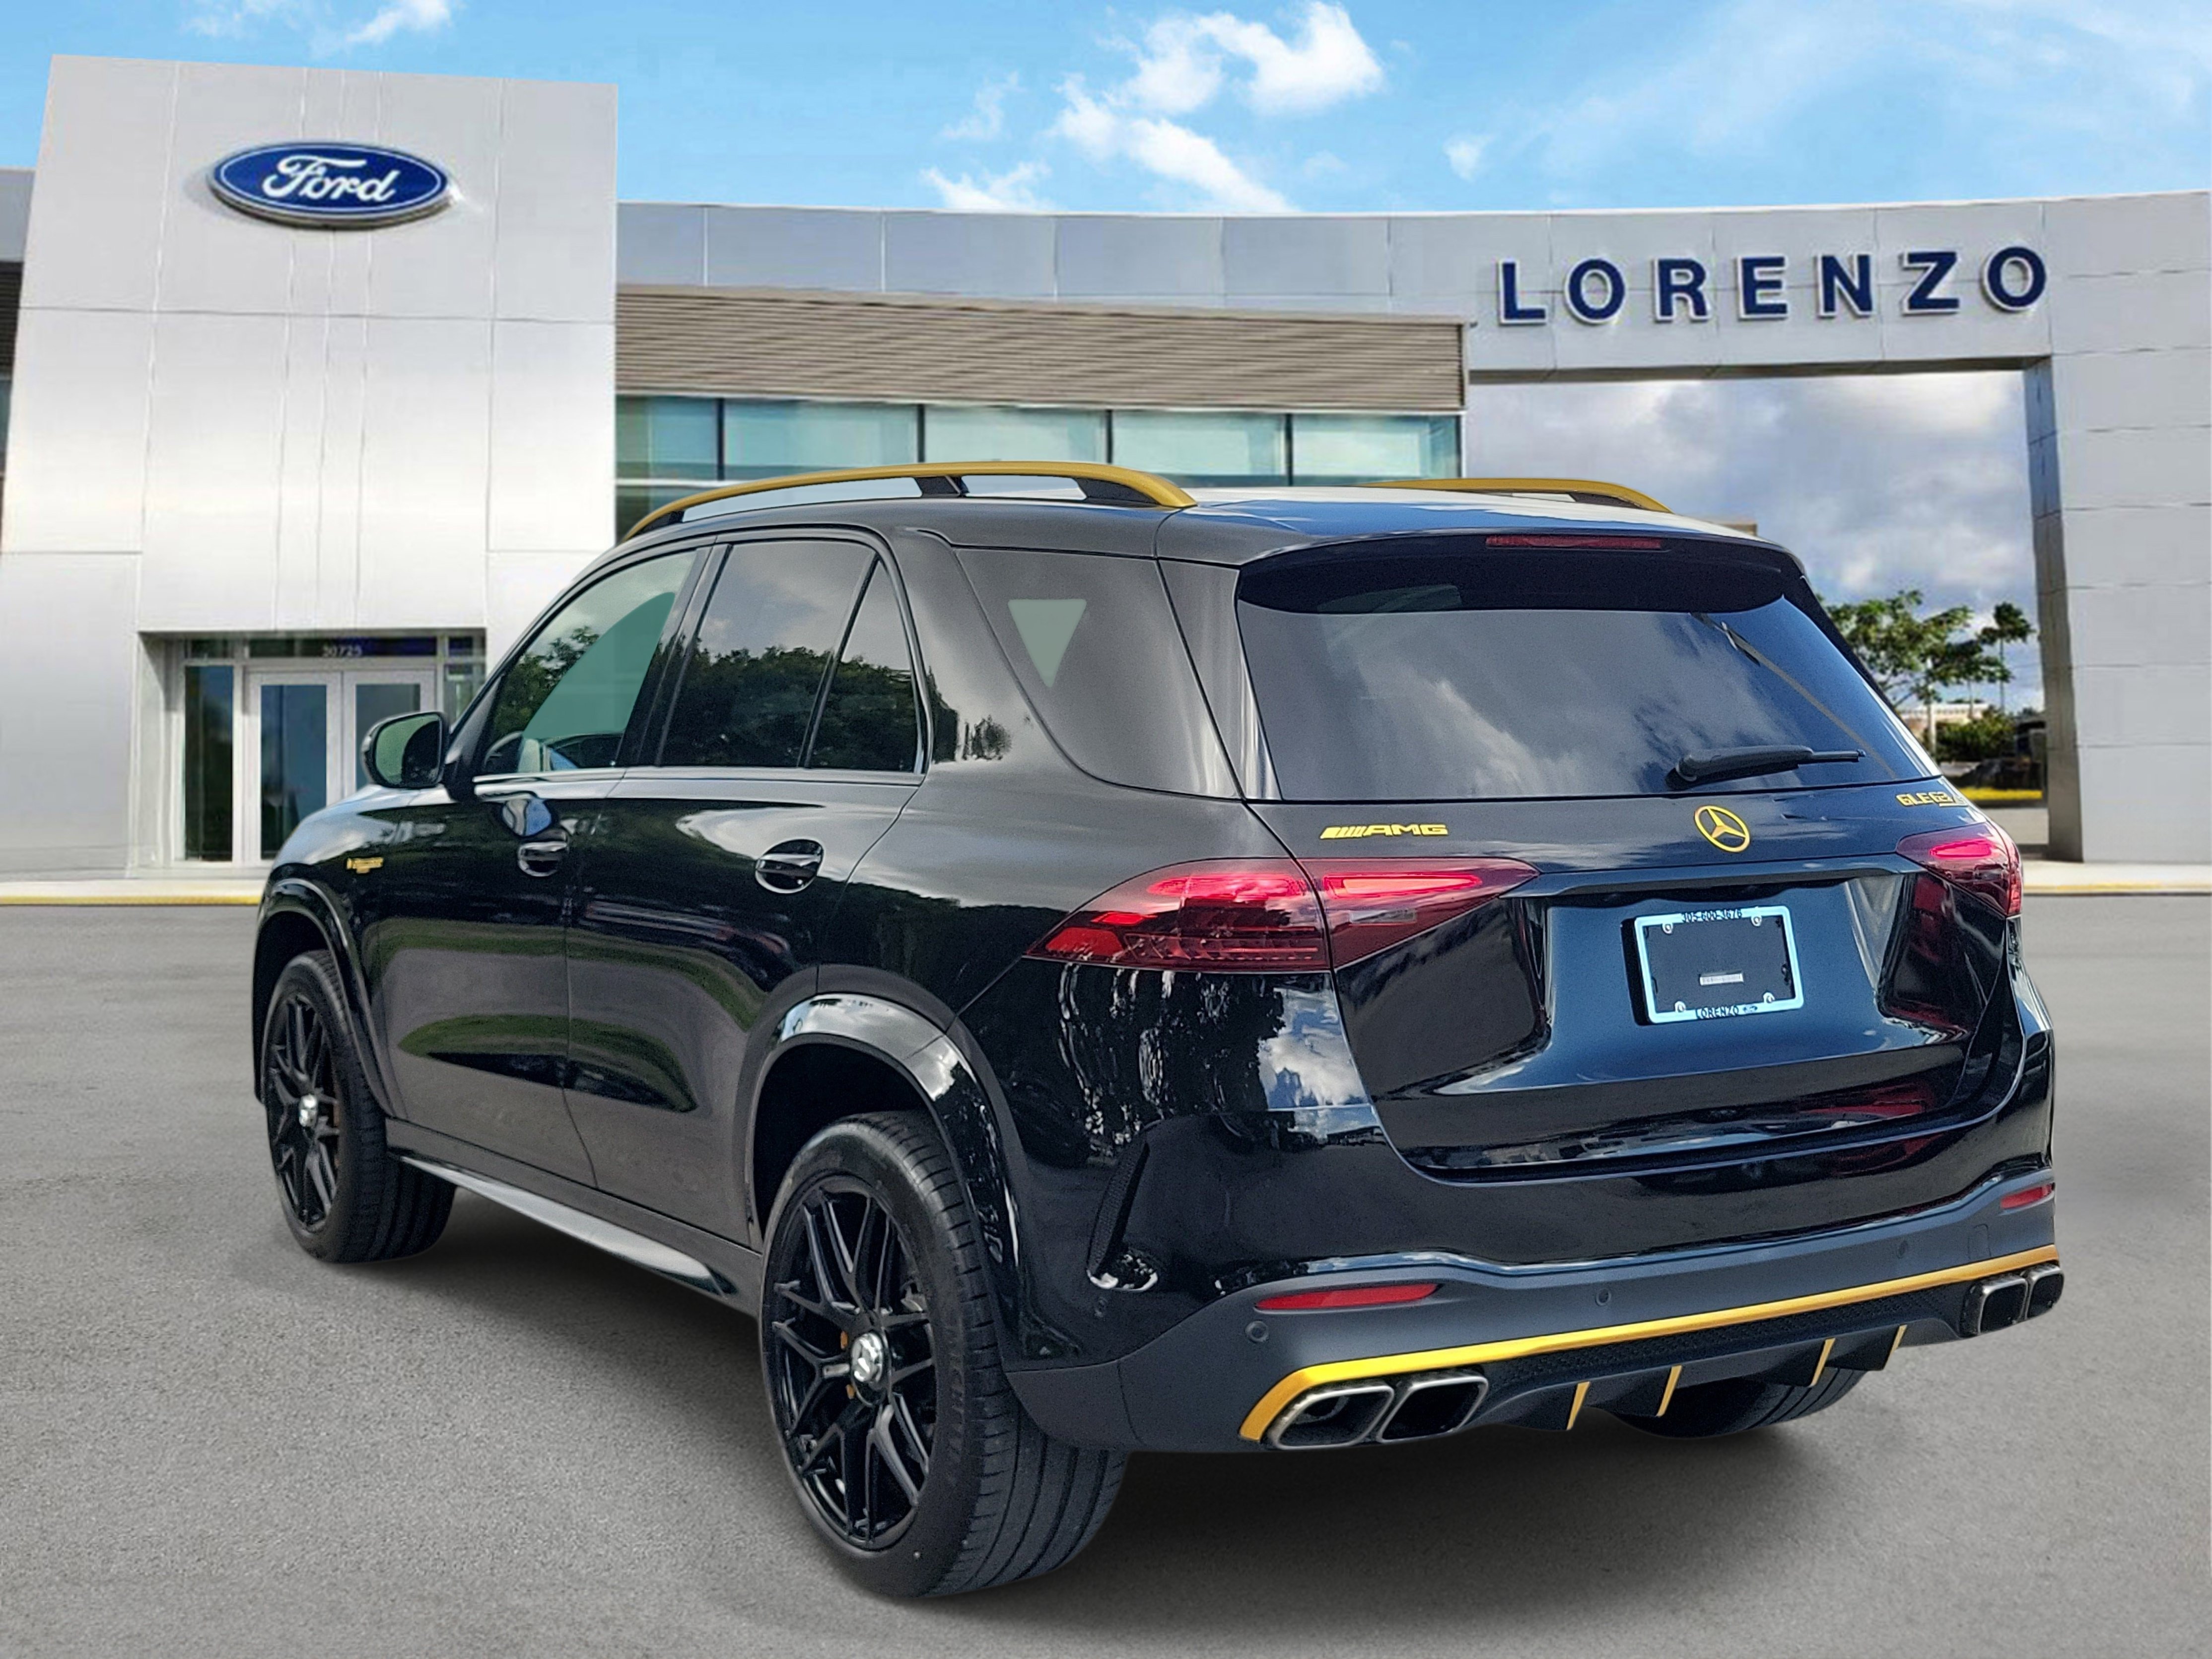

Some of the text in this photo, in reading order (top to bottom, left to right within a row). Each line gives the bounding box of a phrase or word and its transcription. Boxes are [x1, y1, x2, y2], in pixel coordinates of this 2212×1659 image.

[262, 154, 400, 202] Ford
[1497, 246, 2047, 326] LORENZO
[1362, 824, 1449, 836] AMG
[1695, 1006, 1739, 1020] LORENZO
